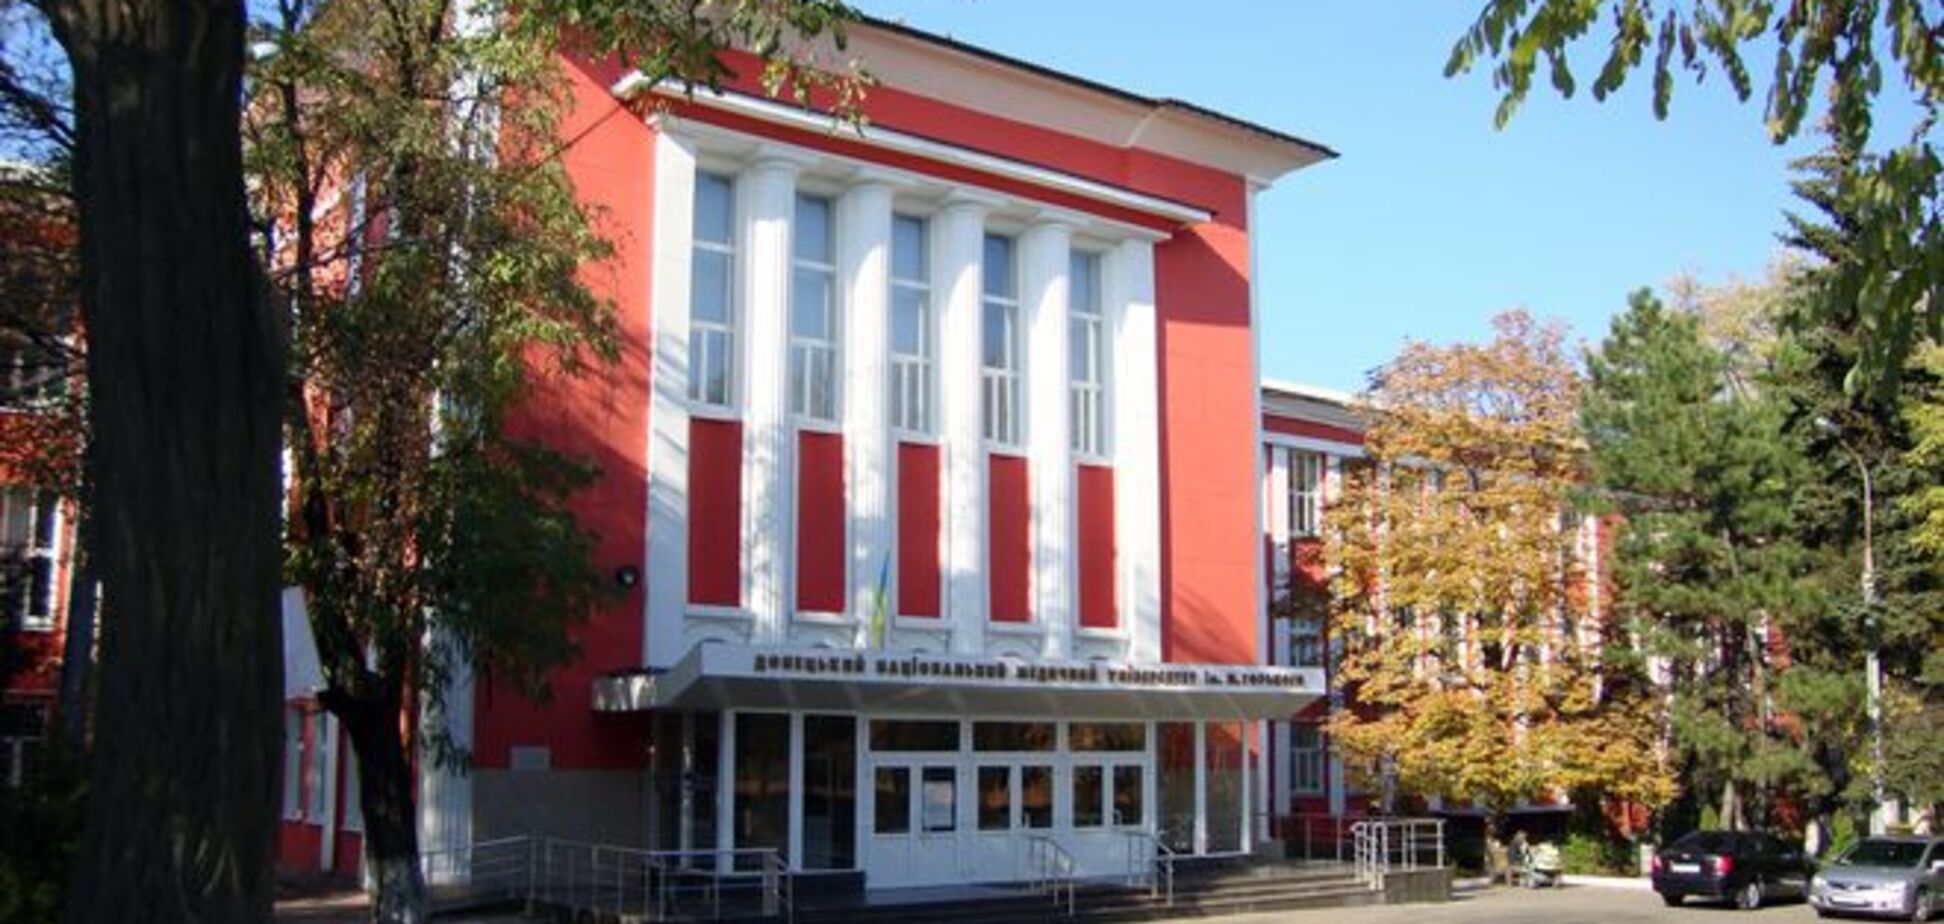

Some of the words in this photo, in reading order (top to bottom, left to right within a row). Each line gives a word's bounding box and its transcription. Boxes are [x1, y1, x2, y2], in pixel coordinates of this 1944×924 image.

[754, 654, 866, 674] ДОНЕЦЬКИЙ
[876, 656, 1006, 678] НАЦІОНАЛЬНИЙ
[1017, 662, 1096, 682] МЕДИЧНИЙ
[1107, 664, 1196, 685] УНІВЕРСИТЕТ
